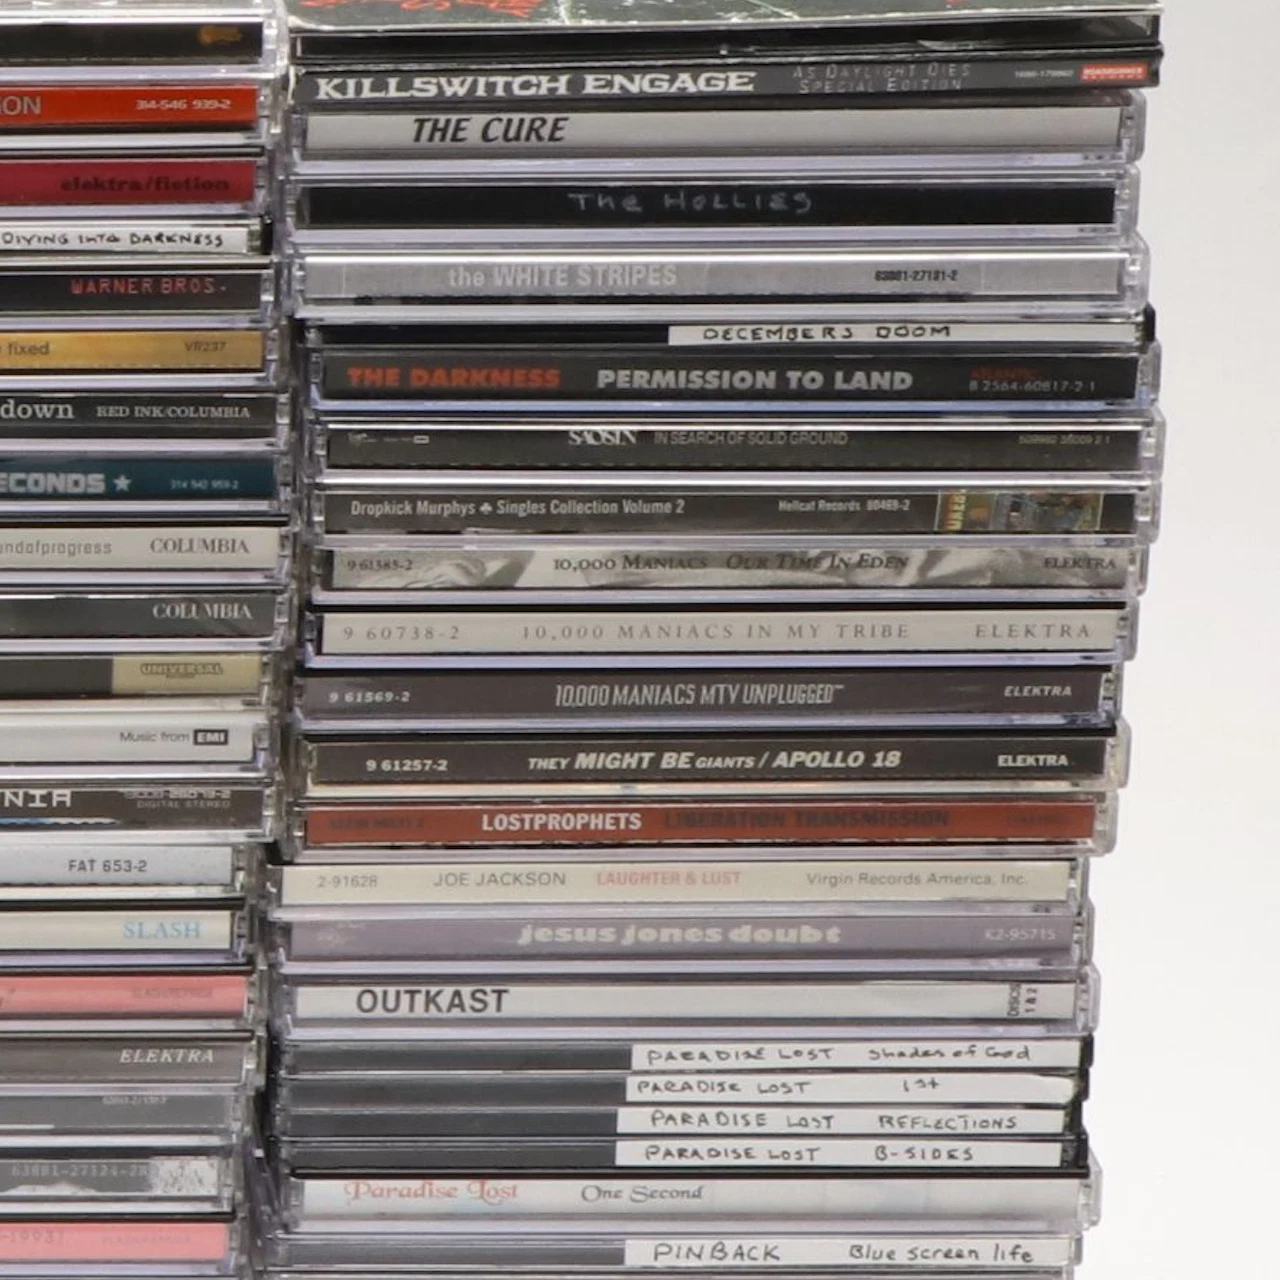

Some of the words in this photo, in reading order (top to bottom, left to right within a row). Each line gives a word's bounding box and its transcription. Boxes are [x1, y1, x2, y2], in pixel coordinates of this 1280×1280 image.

[317, 75, 573, 100] KILLSWITCH
[583, 72, 756, 98] ENGAGE
[412, 116, 470, 142] THE
[482, 115, 568, 142] CURE
[450, 266, 487, 286] the
[495, 264, 572, 289] WHITE
[578, 264, 677, 288] STRIPES
[8, 343, 49, 355] fixed
[348, 369, 401, 388] THE
[410, 367, 560, 388] DARKNESS
[598, 369, 779, 393] PERMISSION
[786, 371, 823, 389] TO
[835, 372, 912, 389] LAND
[351, 501, 412, 517] Dropkick
[417, 501, 475, 517] Murphys
[497, 500, 546, 517] Singles
[550, 500, 618, 514] Collection
[623, 500, 672, 513] Volume
[676, 499, 685, 513] 2
[150, 539, 249, 553] COLUMBIA
[483, 813, 641, 830] LOSTPROPHETS
[69, 859, 95, 871] FAT
[103, 860, 146, 872] 653-2
[434, 872, 469, 886] JOE
[476, 872, 566, 886] JACKSON
[357, 989, 508, 1012] OUTKAST
[651, 1110, 766, 1126] PARADISE
[654, 1242, 780, 1261] PINBACK
[850, 1245, 895, 1260] Blue
[908, 1242, 979, 1260] screen
[994, 1244, 1033, 1263] life
